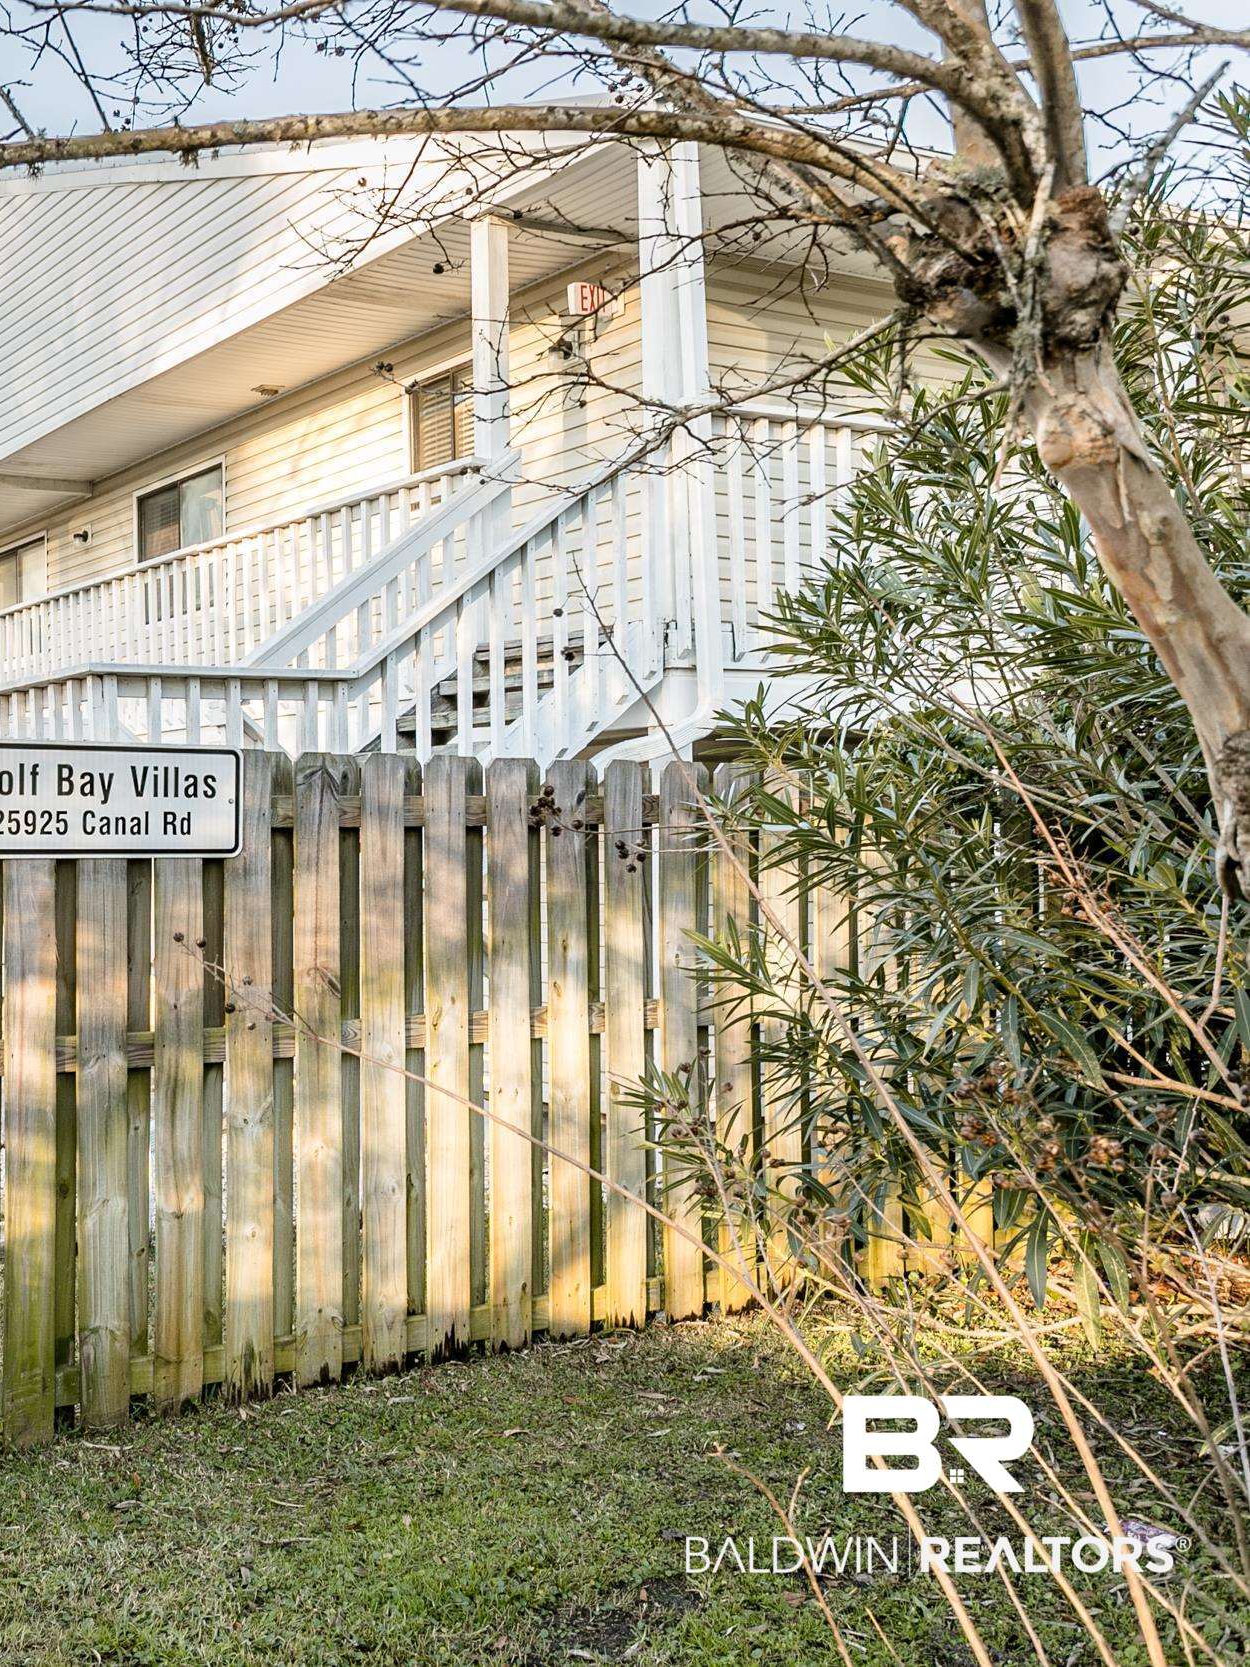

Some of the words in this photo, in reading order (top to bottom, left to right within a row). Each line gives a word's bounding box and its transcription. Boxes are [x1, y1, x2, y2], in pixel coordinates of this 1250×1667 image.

[56, 763, 115, 805] Bay
[130, 765, 218, 799] Villas
[82, 810, 150, 836] Canal
[162, 811, 192, 836] Rd
